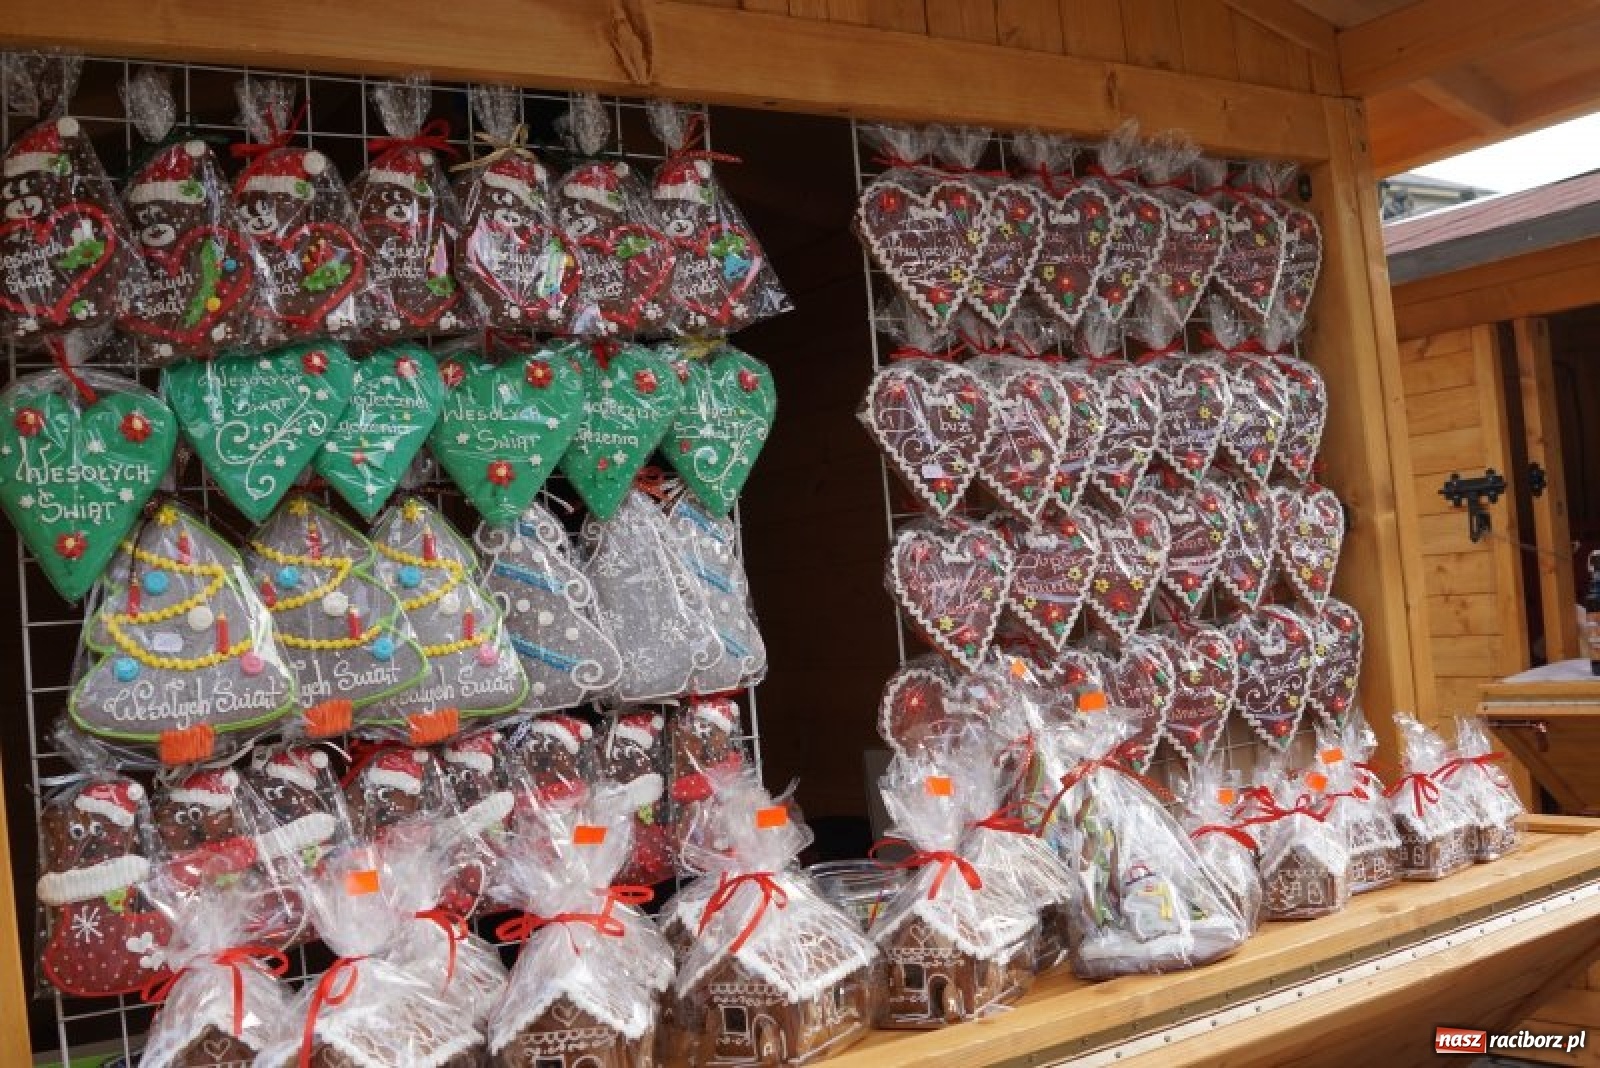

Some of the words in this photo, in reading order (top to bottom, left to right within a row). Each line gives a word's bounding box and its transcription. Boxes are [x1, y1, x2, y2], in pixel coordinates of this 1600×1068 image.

[333, 651, 401, 691] Świąt
[457, 653, 516, 698] Świąt
[102, 677, 212, 731] Wesołych
[212, 669, 283, 714] Świąt
